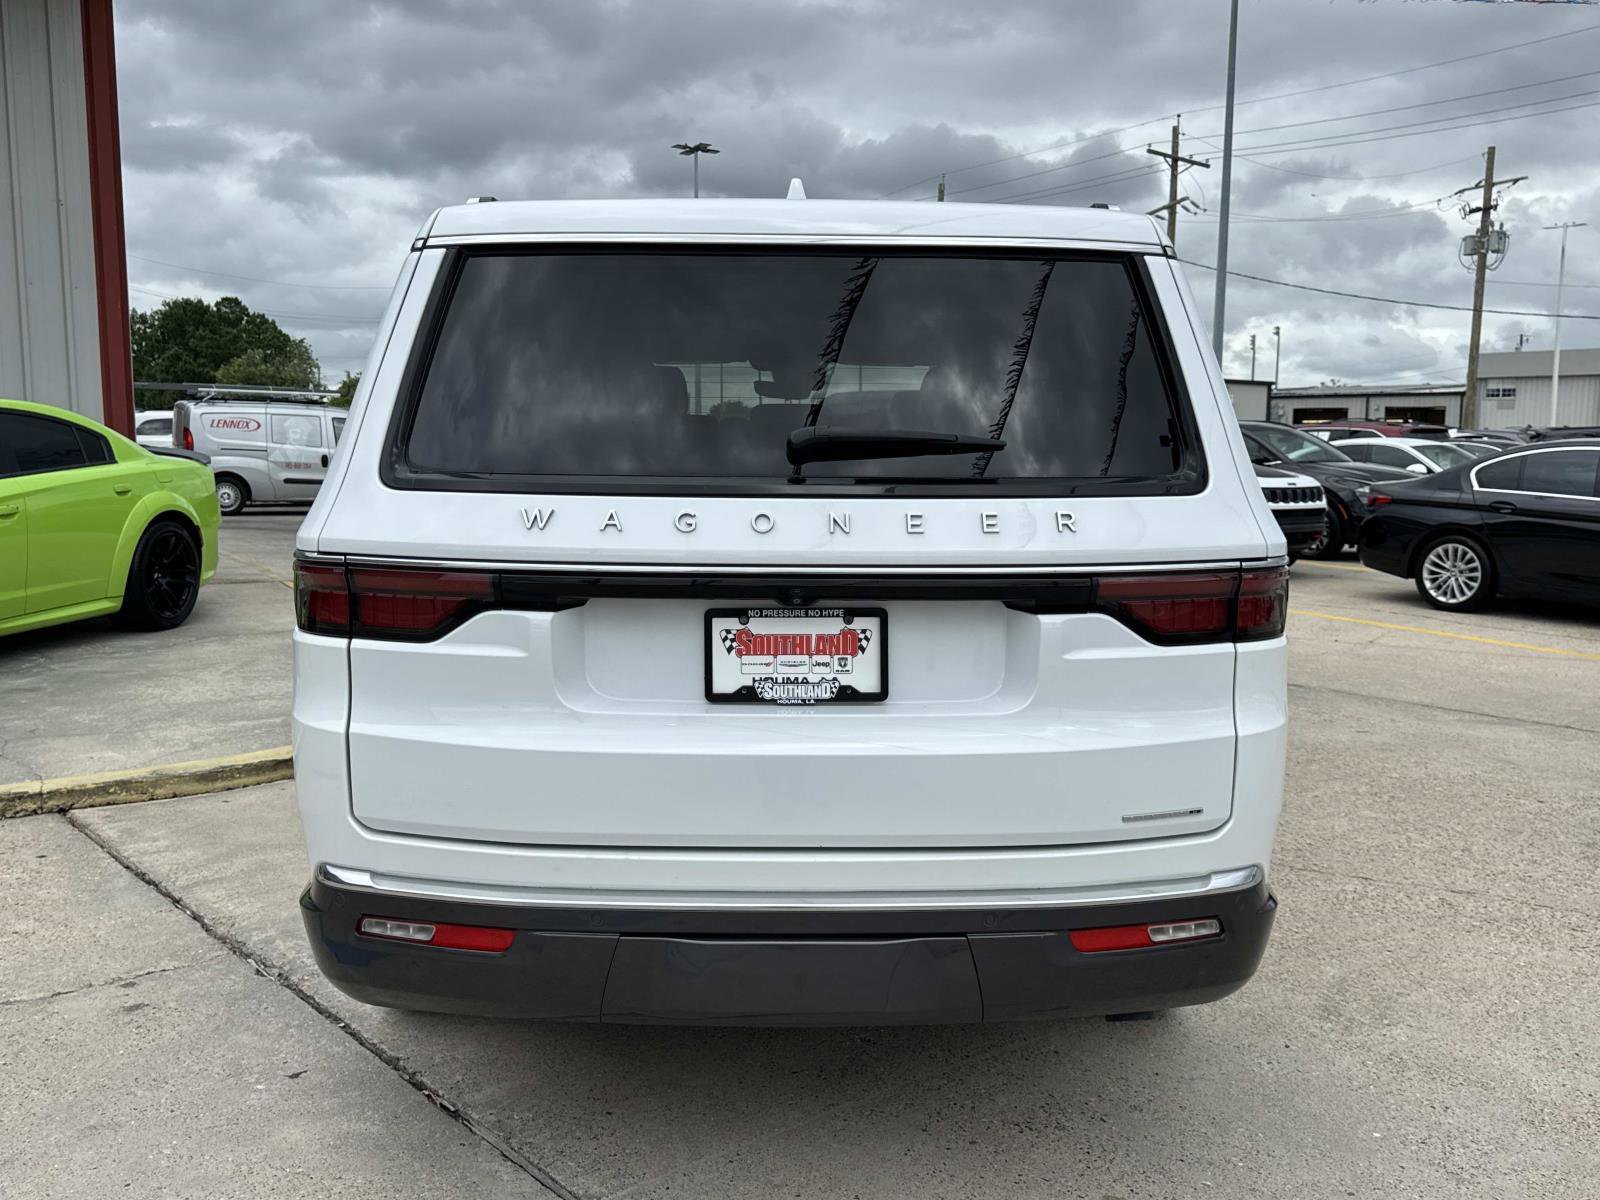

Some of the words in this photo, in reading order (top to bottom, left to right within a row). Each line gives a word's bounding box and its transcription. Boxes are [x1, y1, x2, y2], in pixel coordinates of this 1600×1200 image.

[210, 419, 251, 430] LENNOX
[520, 507, 1077, 534] WAGONEER
[748, 609, 760, 617] NO
[762, 609, 806, 617] PRESSURE
[808, 609, 820, 617] NO
[822, 609, 845, 617] HYPE
[735, 629, 859, 658] SOUTHLAND
[812, 660, 830, 668] Jeep
[764, 681, 832, 699] SOUTHLAND
